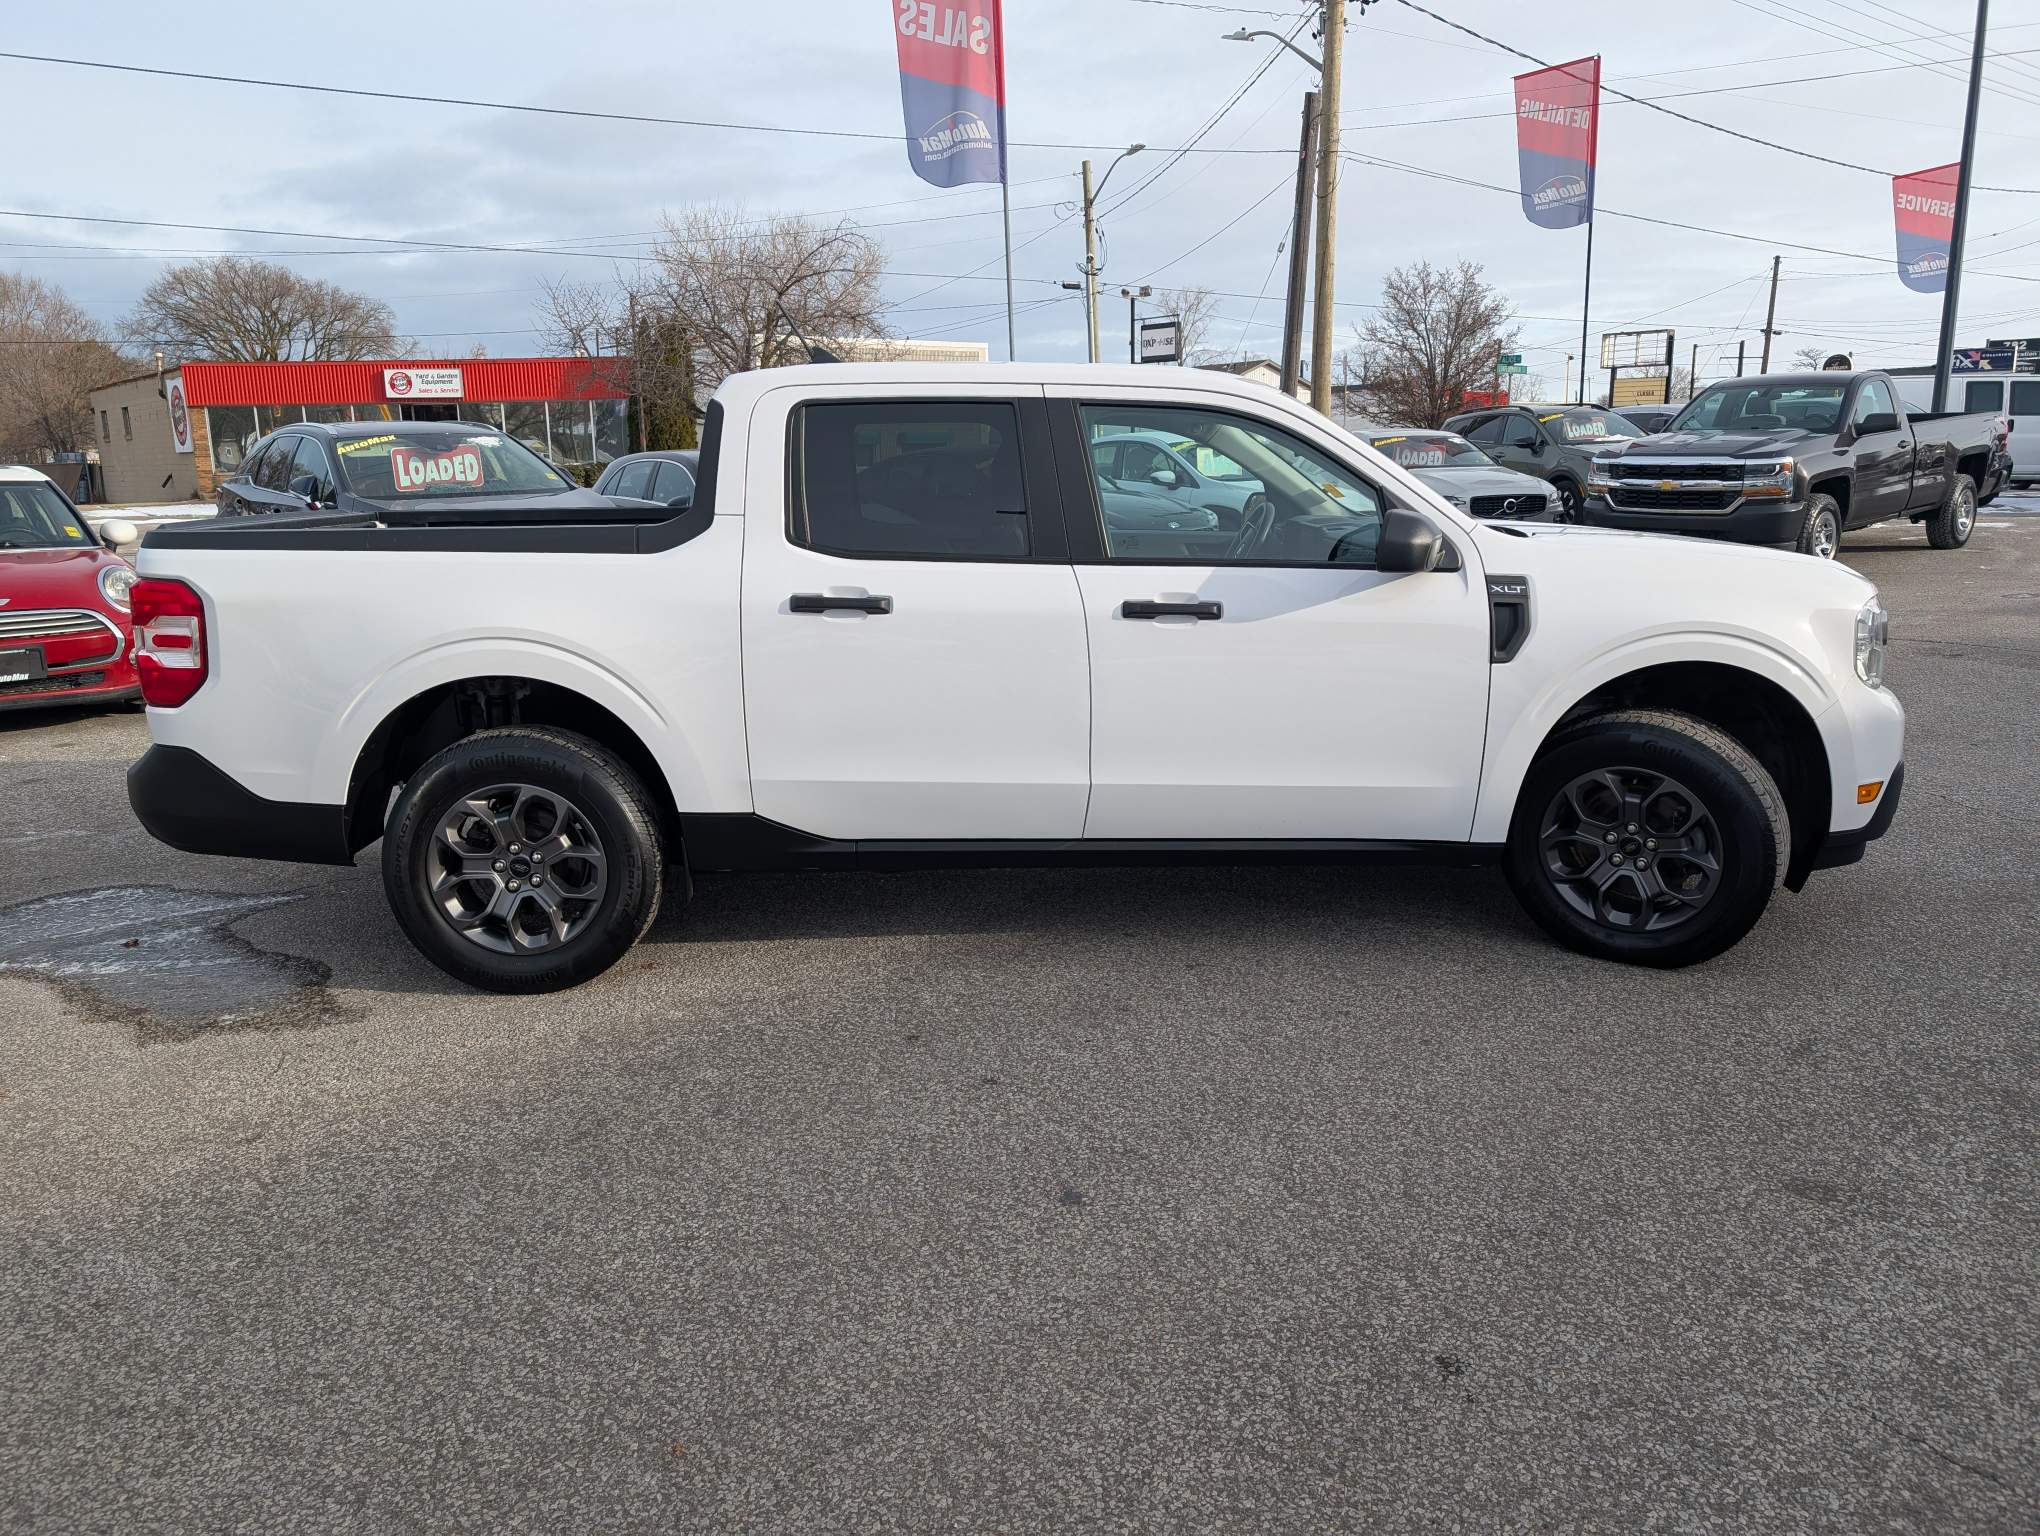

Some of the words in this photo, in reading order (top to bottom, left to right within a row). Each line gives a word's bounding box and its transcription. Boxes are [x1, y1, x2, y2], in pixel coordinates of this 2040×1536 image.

[1566, 421, 1605, 438] LOADED
[337, 434, 397, 455] AutoMax
[1395, 446, 1443, 465] LOADED
[396, 453, 479, 487] LOADED
[1490, 584, 1527, 593] XLT
[0, 673, 30, 683] utoMax
